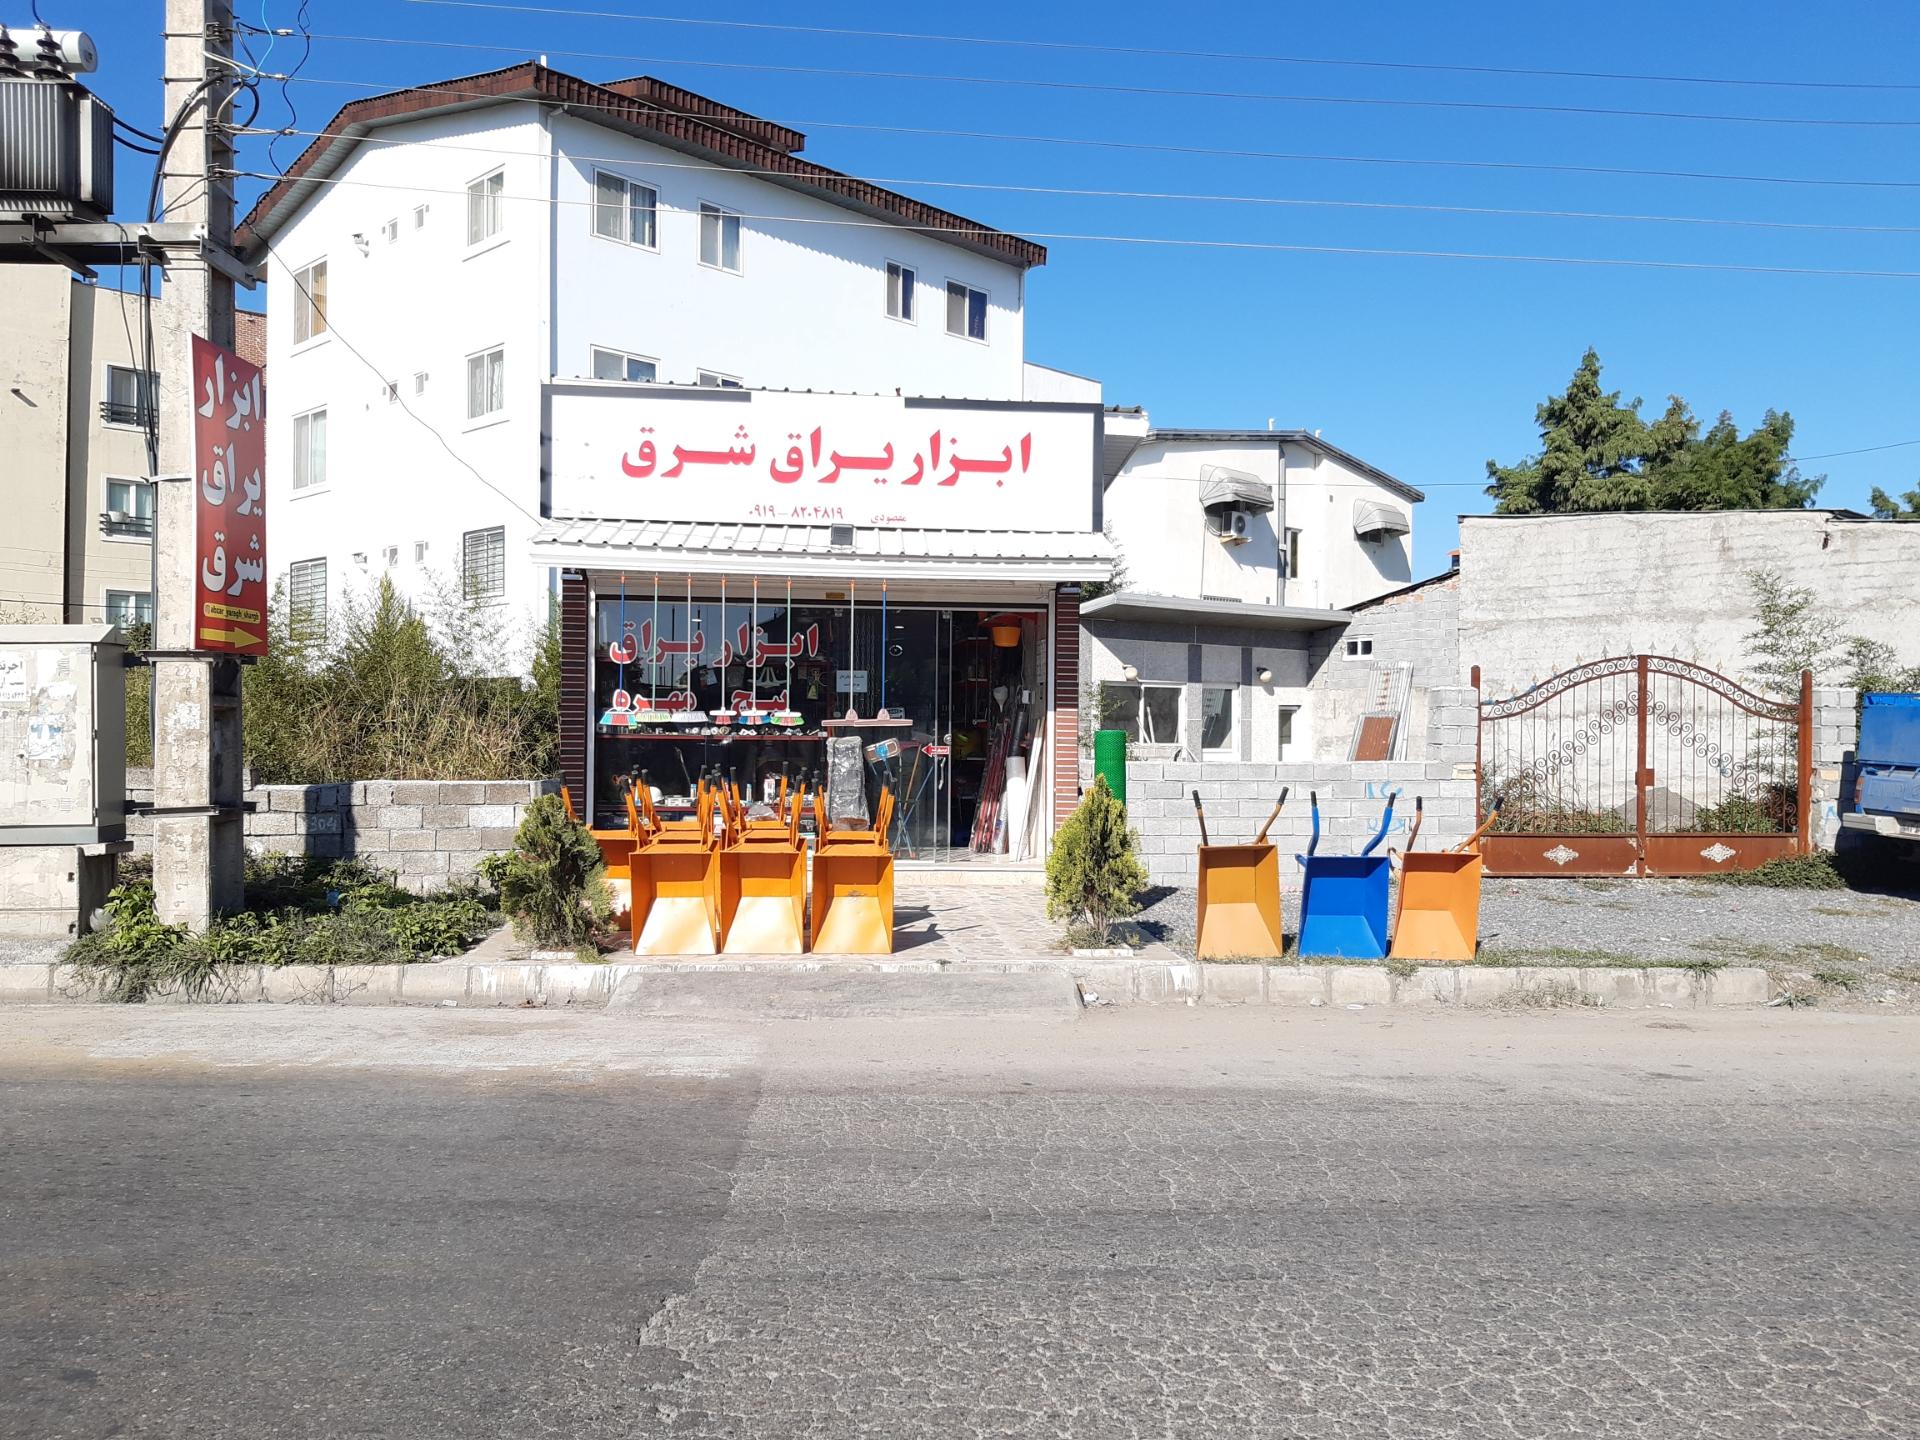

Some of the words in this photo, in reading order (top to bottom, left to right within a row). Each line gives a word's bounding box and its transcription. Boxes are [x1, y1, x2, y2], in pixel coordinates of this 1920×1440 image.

[199, 353, 262, 431] ابزار
[202, 442, 263, 517] یراق
[621, 424, 756, 479] شرق
[770, 426, 893, 485] یراق
[902, 430, 1032, 487] ابزار
[202, 530, 264, 596] شرق
[609, 618, 706, 667] یراق
[711, 622, 819, 668] ابزار
